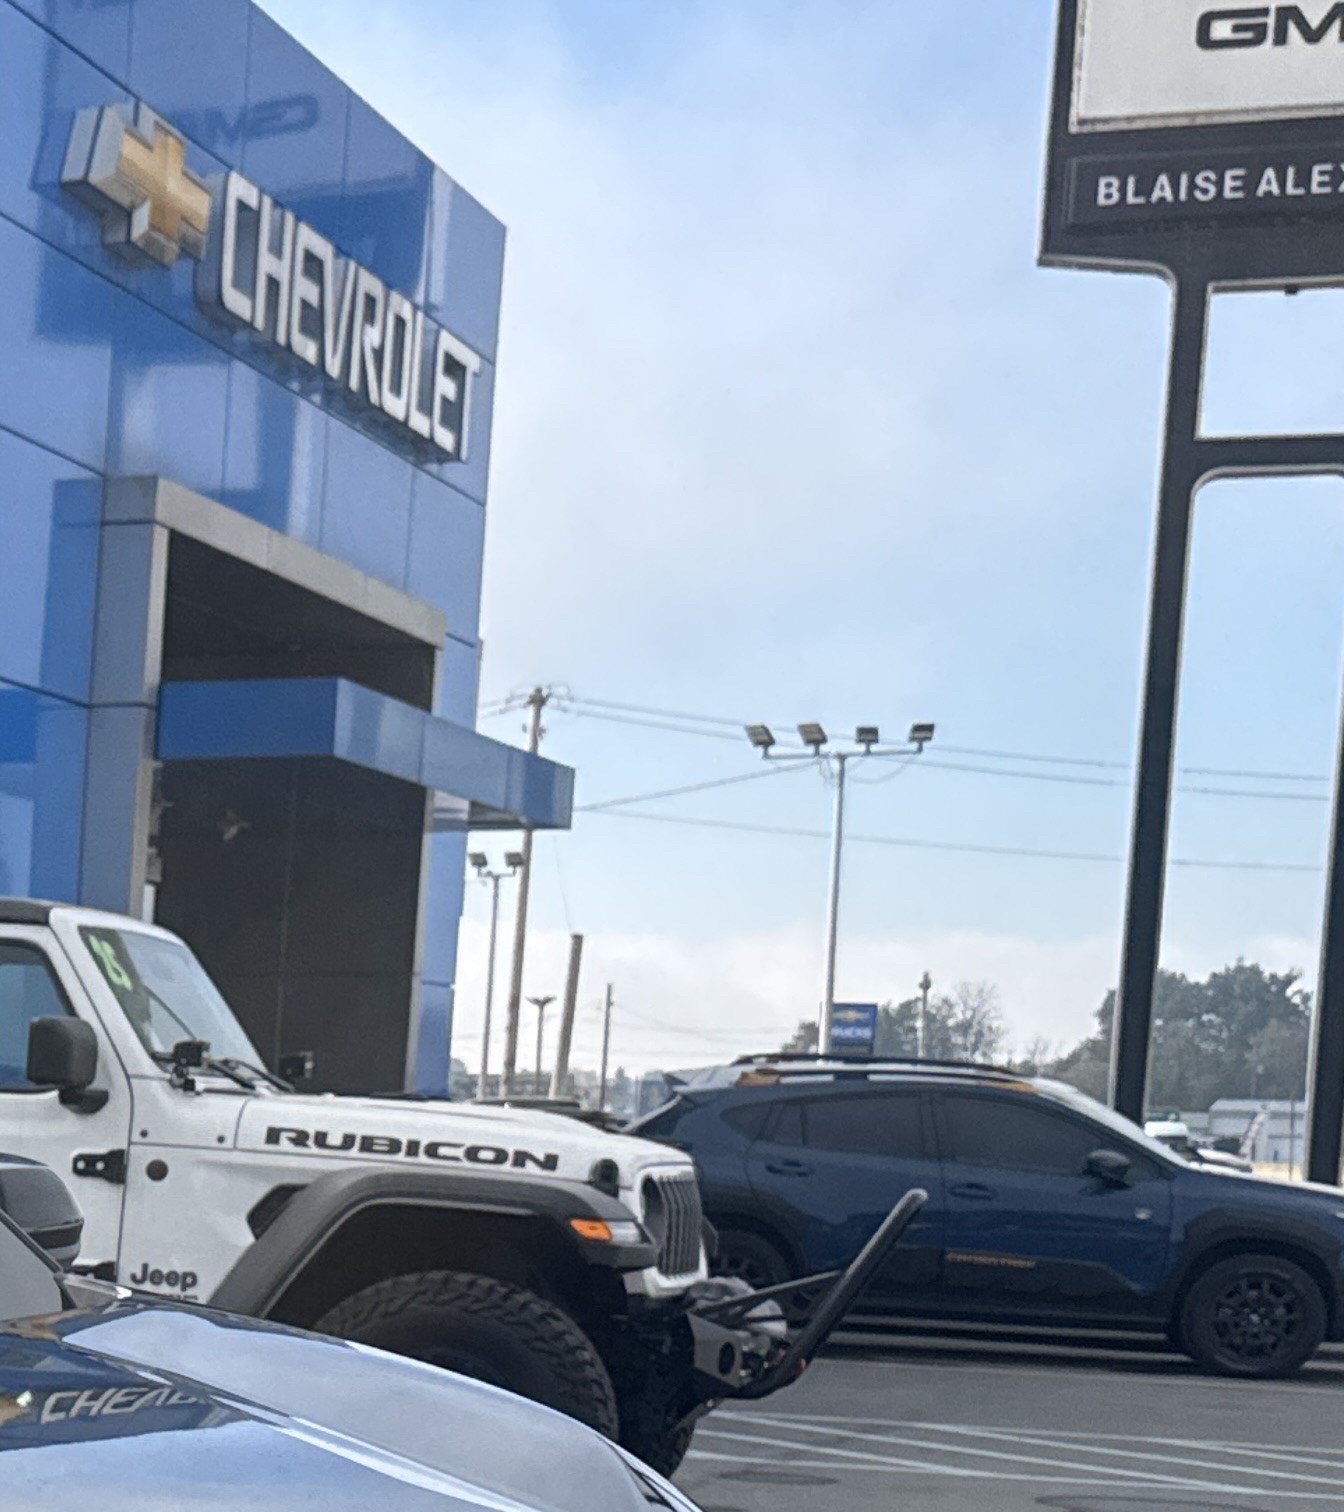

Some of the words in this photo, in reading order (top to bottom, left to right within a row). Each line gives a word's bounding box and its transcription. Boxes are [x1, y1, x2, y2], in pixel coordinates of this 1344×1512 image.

[1096, 168, 1248, 207] BLAISE
[220, 170, 481, 462] CHEVROLET
[265, 1126, 559, 1172] RUBICON
[130, 1263, 198, 1292] Jeep
